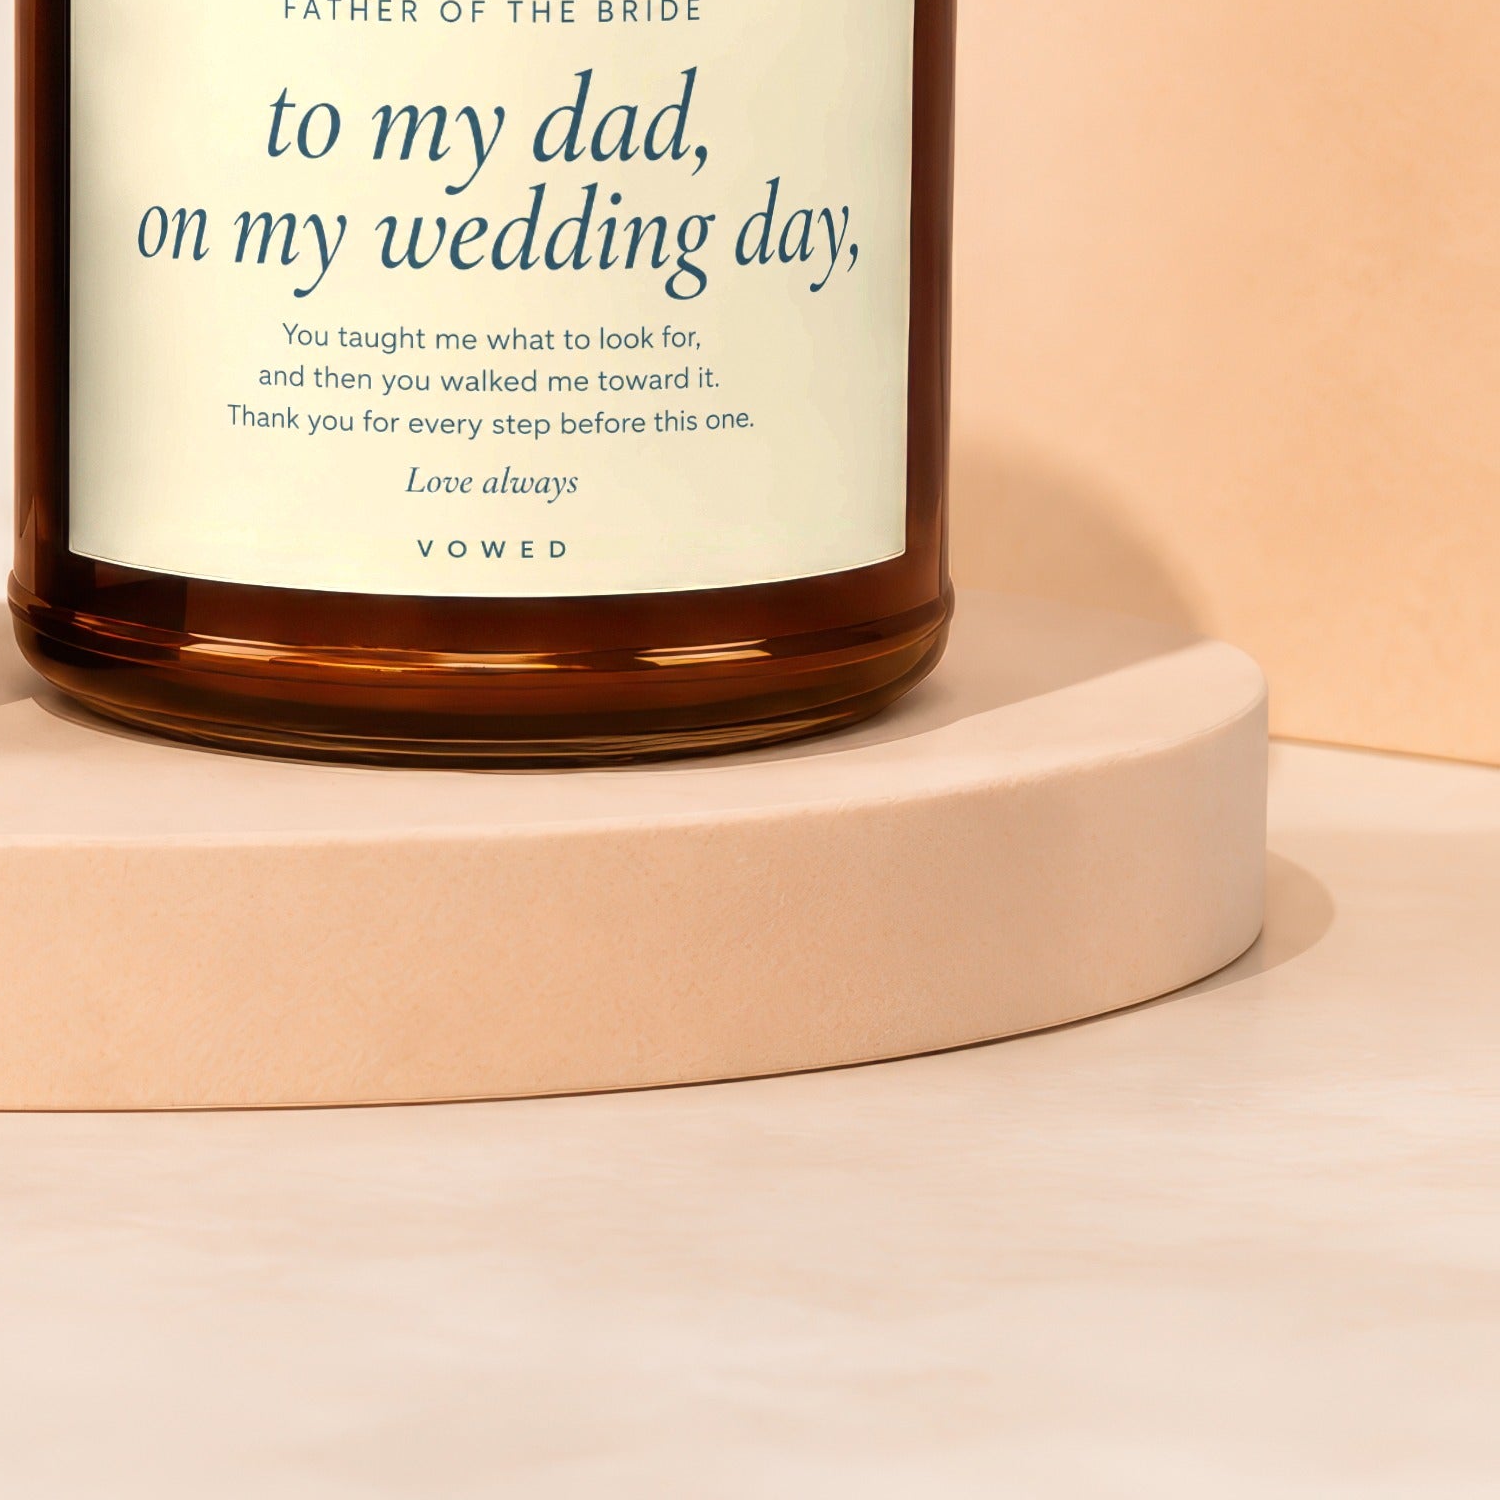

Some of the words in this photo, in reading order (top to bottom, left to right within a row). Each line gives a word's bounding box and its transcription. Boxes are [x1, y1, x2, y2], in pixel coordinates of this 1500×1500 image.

[439, 0, 486, 24] OF
[506, 0, 575, 24] THE
[267, 86, 341, 160] to
[371, 104, 506, 196] my
[532, 65, 709, 177] dad,
[137, 205, 210, 262] on
[233, 210, 348, 299] my
[374, 181, 717, 301] wedding
[734, 175, 859, 293] day,
[282, 322, 329, 347] You
[337, 325, 426, 355] taught
[435, 332, 478, 351] me
[486, 326, 555, 351] what
[563, 329, 591, 351] to
[599, 325, 655, 350] look
[661, 324, 701, 351] for,
[258, 364, 304, 387] and
[313, 365, 372, 390] then
[381, 374, 430, 396] you
[440, 368, 538, 393] walked
[548, 375, 589, 392] me
[597, 365, 690, 392] toward
[698, 366, 720, 389] it.
[227, 403, 300, 430] Thank
[307, 414, 354, 436] you
[362, 409, 400, 433] for
[408, 417, 483, 441] every
[492, 414, 551, 441] step
[560, 410, 646, 435] before
[653, 409, 698, 433] this
[705, 412, 754, 431] one.
[404, 466, 473, 494] Love
[482, 465, 579, 505] always
[416, 539, 567, 559] VOWED
